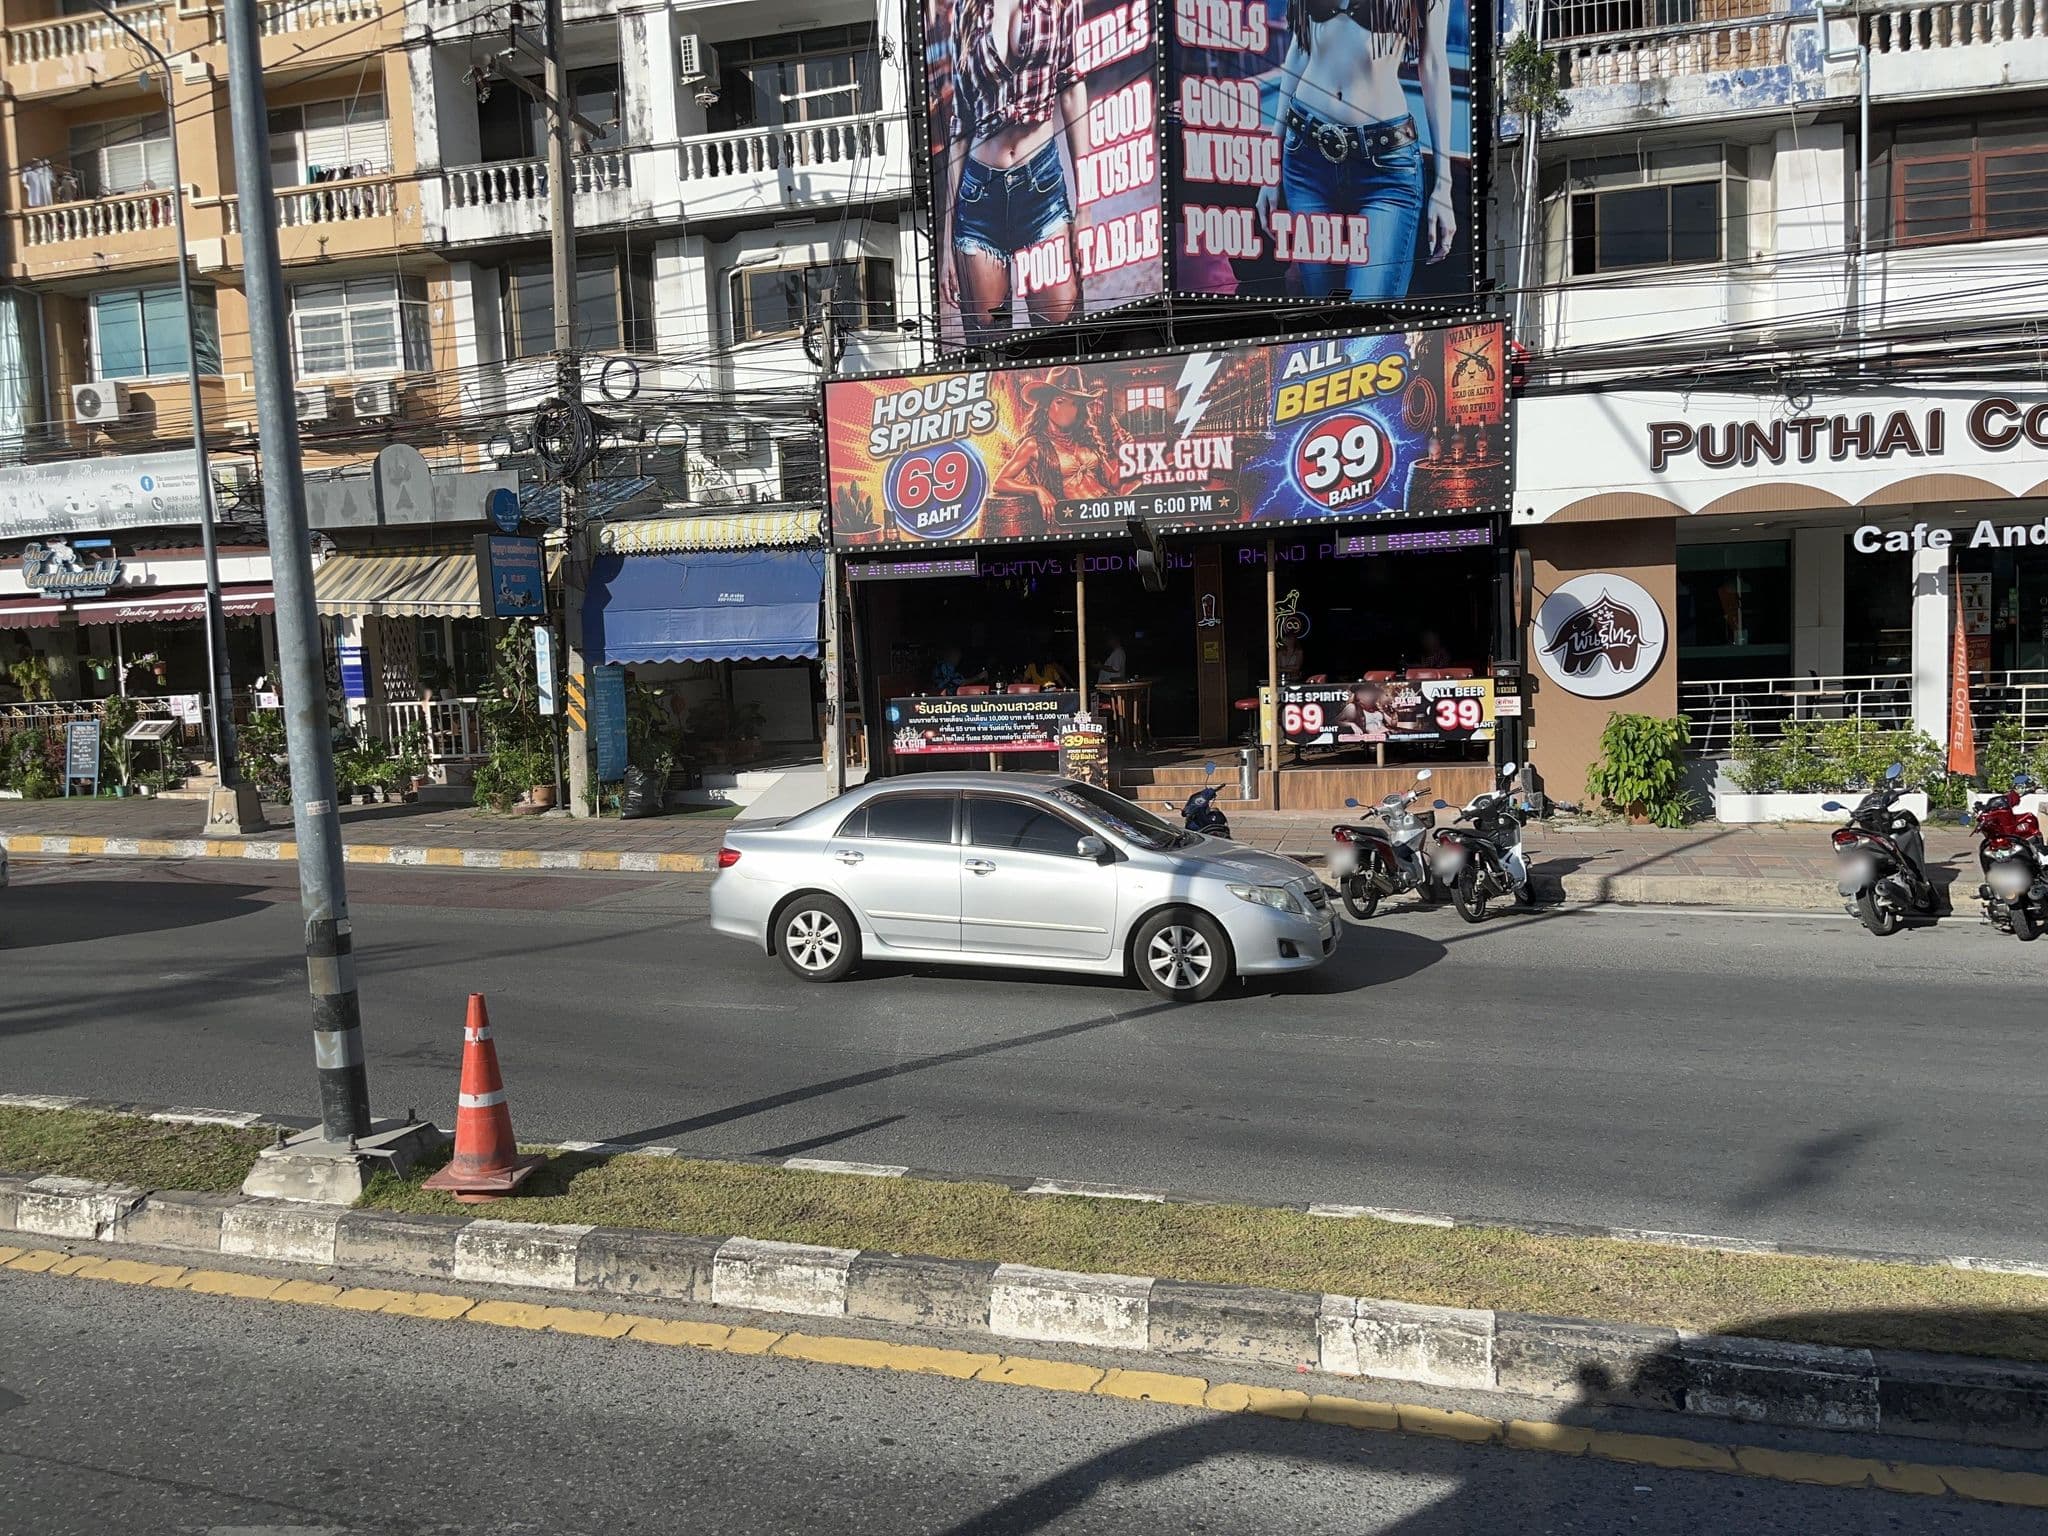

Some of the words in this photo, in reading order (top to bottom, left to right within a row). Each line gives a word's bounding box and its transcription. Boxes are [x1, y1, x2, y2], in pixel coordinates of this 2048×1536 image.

[1076, 3, 1149, 71] GIRLS
[1177, 0, 1268, 51] GIRLS
[1090, 82, 1152, 147] GOOD
[1182, 78, 1260, 130] GOOD
[1077, 136, 1154, 204] MUSIC
[1184, 131, 1280, 185] MUSIC
[1184, 206, 1262, 257] POOL
[1272, 213, 1368, 263] TABLE
[1016, 239, 1071, 295] POOL
[1079, 209, 1159, 274] TABLE
[1449, 323, 1497, 344] WANTED
[1282, 342, 1343, 380] ALL
[873, 372, 987, 426] HOUSE
[1275, 355, 1405, 422] BEERS
[1453, 390, 1467, 399] DEAD
[1476, 386, 1495, 396] ALIVE
[1470, 402, 1496, 413] REWARD
[869, 400, 993, 454] SPIRITS
[1647, 407, 1944, 472] PUNTHAI
[1119, 441, 1169, 479] SIX
[1174, 436, 1235, 471] GUN
[1304, 424, 1379, 489] 39
[897, 451, 969, 509] 69
[1143, 469, 1209, 485] SALOON
[1080, 502, 1110, 519] 2:00
[1115, 500, 1136, 516] PM
[1154, 498, 1186, 514] 6:00
[1190, 495, 1213, 512] PM
[1328, 480, 1373, 507] BAHT
[114, 510, 137, 521] Cake
[917, 504, 962, 528] BAHT
[1854, 523, 1953, 554] Cafe
[1968, 517, 2048, 549] And
[1128, 552, 1193, 571] MSIC
[1238, 544, 1306, 564] RHNO
[23, 560, 121, 589] Continental
[115, 605, 160, 618] Bakery
[163, 604, 187, 614] and
[188, 601, 258, 613] Reurant
[1263, 691, 1303, 704] HUSE
[1304, 690, 1349, 702] SPIRITS
[1431, 687, 1453, 698] ALL
[1455, 686, 1485, 698] BEER
[919, 701, 968, 714] รับสมัคร
[970, 701, 1058, 713] พนักงานสาวสวย
[988, 714, 1009, 722] 10,000
[1036, 713, 1056, 721] 15,000
[1283, 703, 1323, 735] 69
[1436, 698, 1480, 731] 39
[1953, 687, 1966, 752] COFFEE
[1062, 724, 1078, 735] ALL
[1079, 723, 1103, 734] BEER
[1319, 725, 1339, 733] BAHT
[1473, 721, 1495, 729] BAHT
[893, 739, 907, 750] SIX
[1064, 735, 1084, 748] 39
[1084, 736, 1100, 745] Baht
